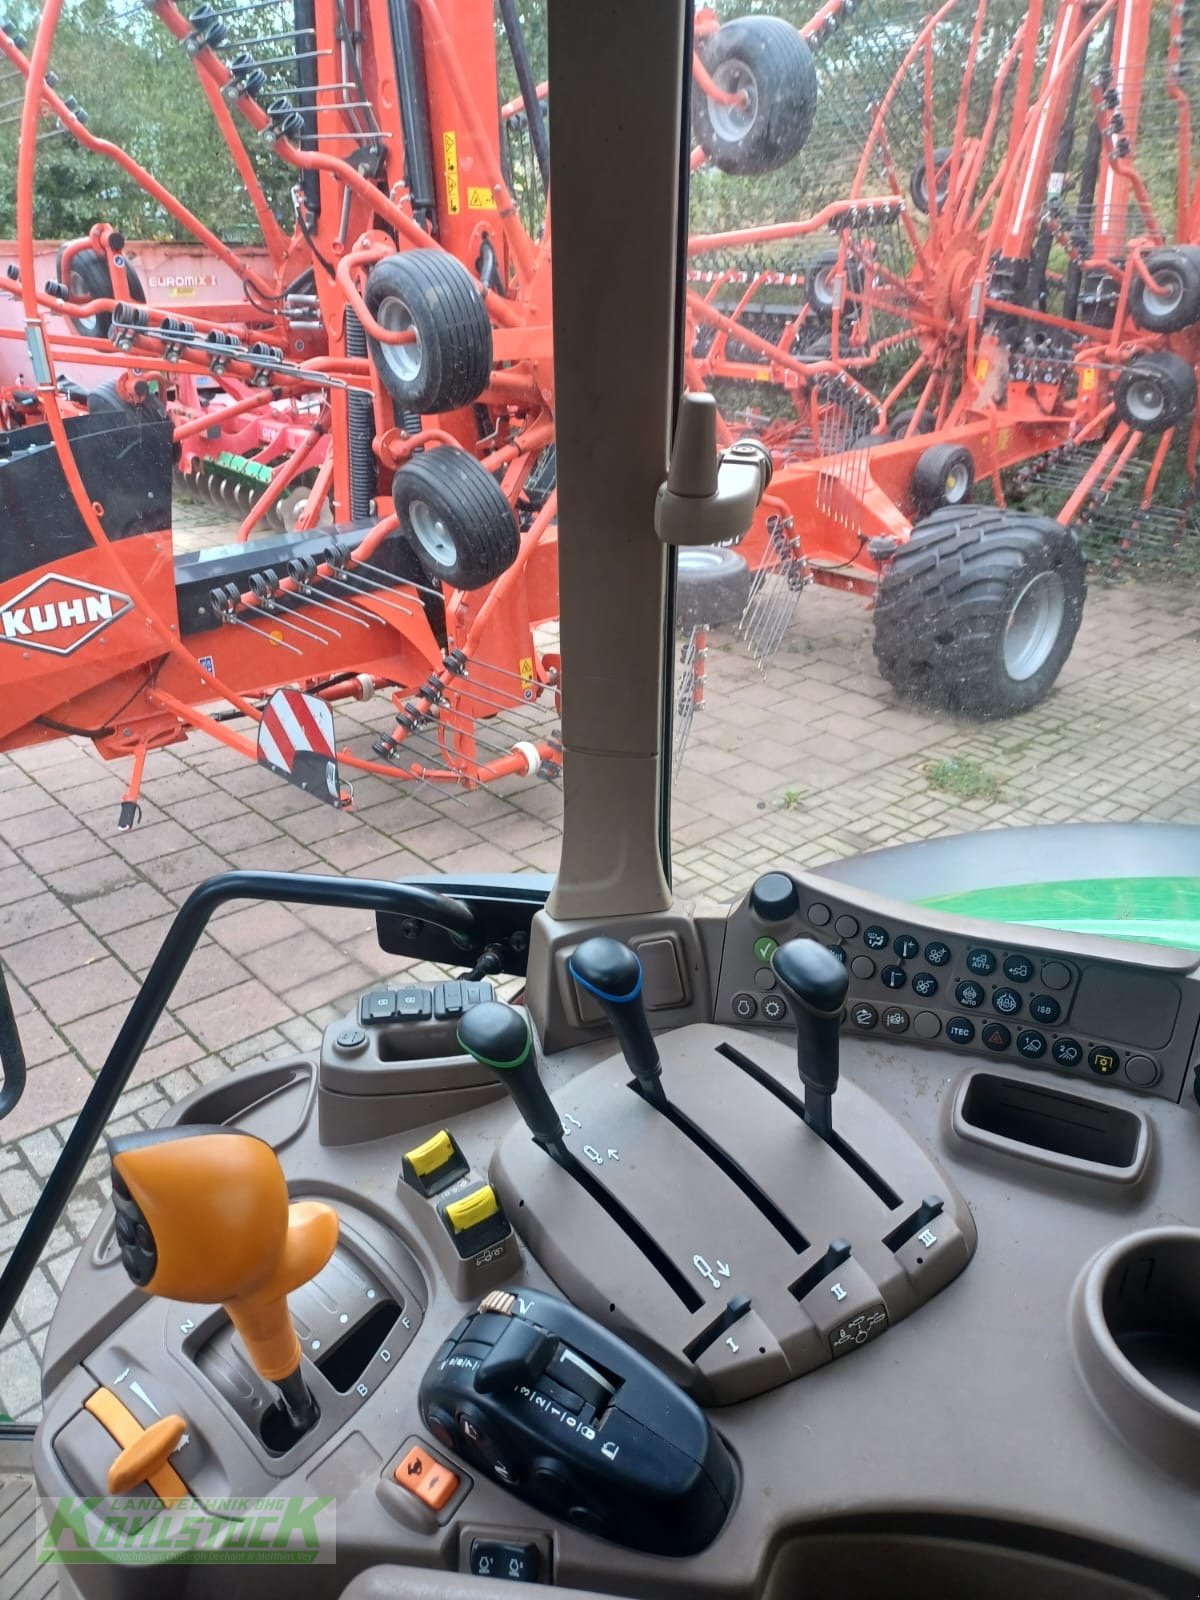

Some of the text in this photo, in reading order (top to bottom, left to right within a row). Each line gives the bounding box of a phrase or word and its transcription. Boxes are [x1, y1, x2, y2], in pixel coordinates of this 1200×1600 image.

[148, 275, 206, 287] EUROMIX
[2, 594, 113, 638] KUHN
[971, 962, 990, 970] AUTO
[402, 1316, 410, 1329] F
[380, 1349, 391, 1362] D
[356, 1383, 368, 1397] B
[520, 1386, 577, 1427] 3 2 1 0
